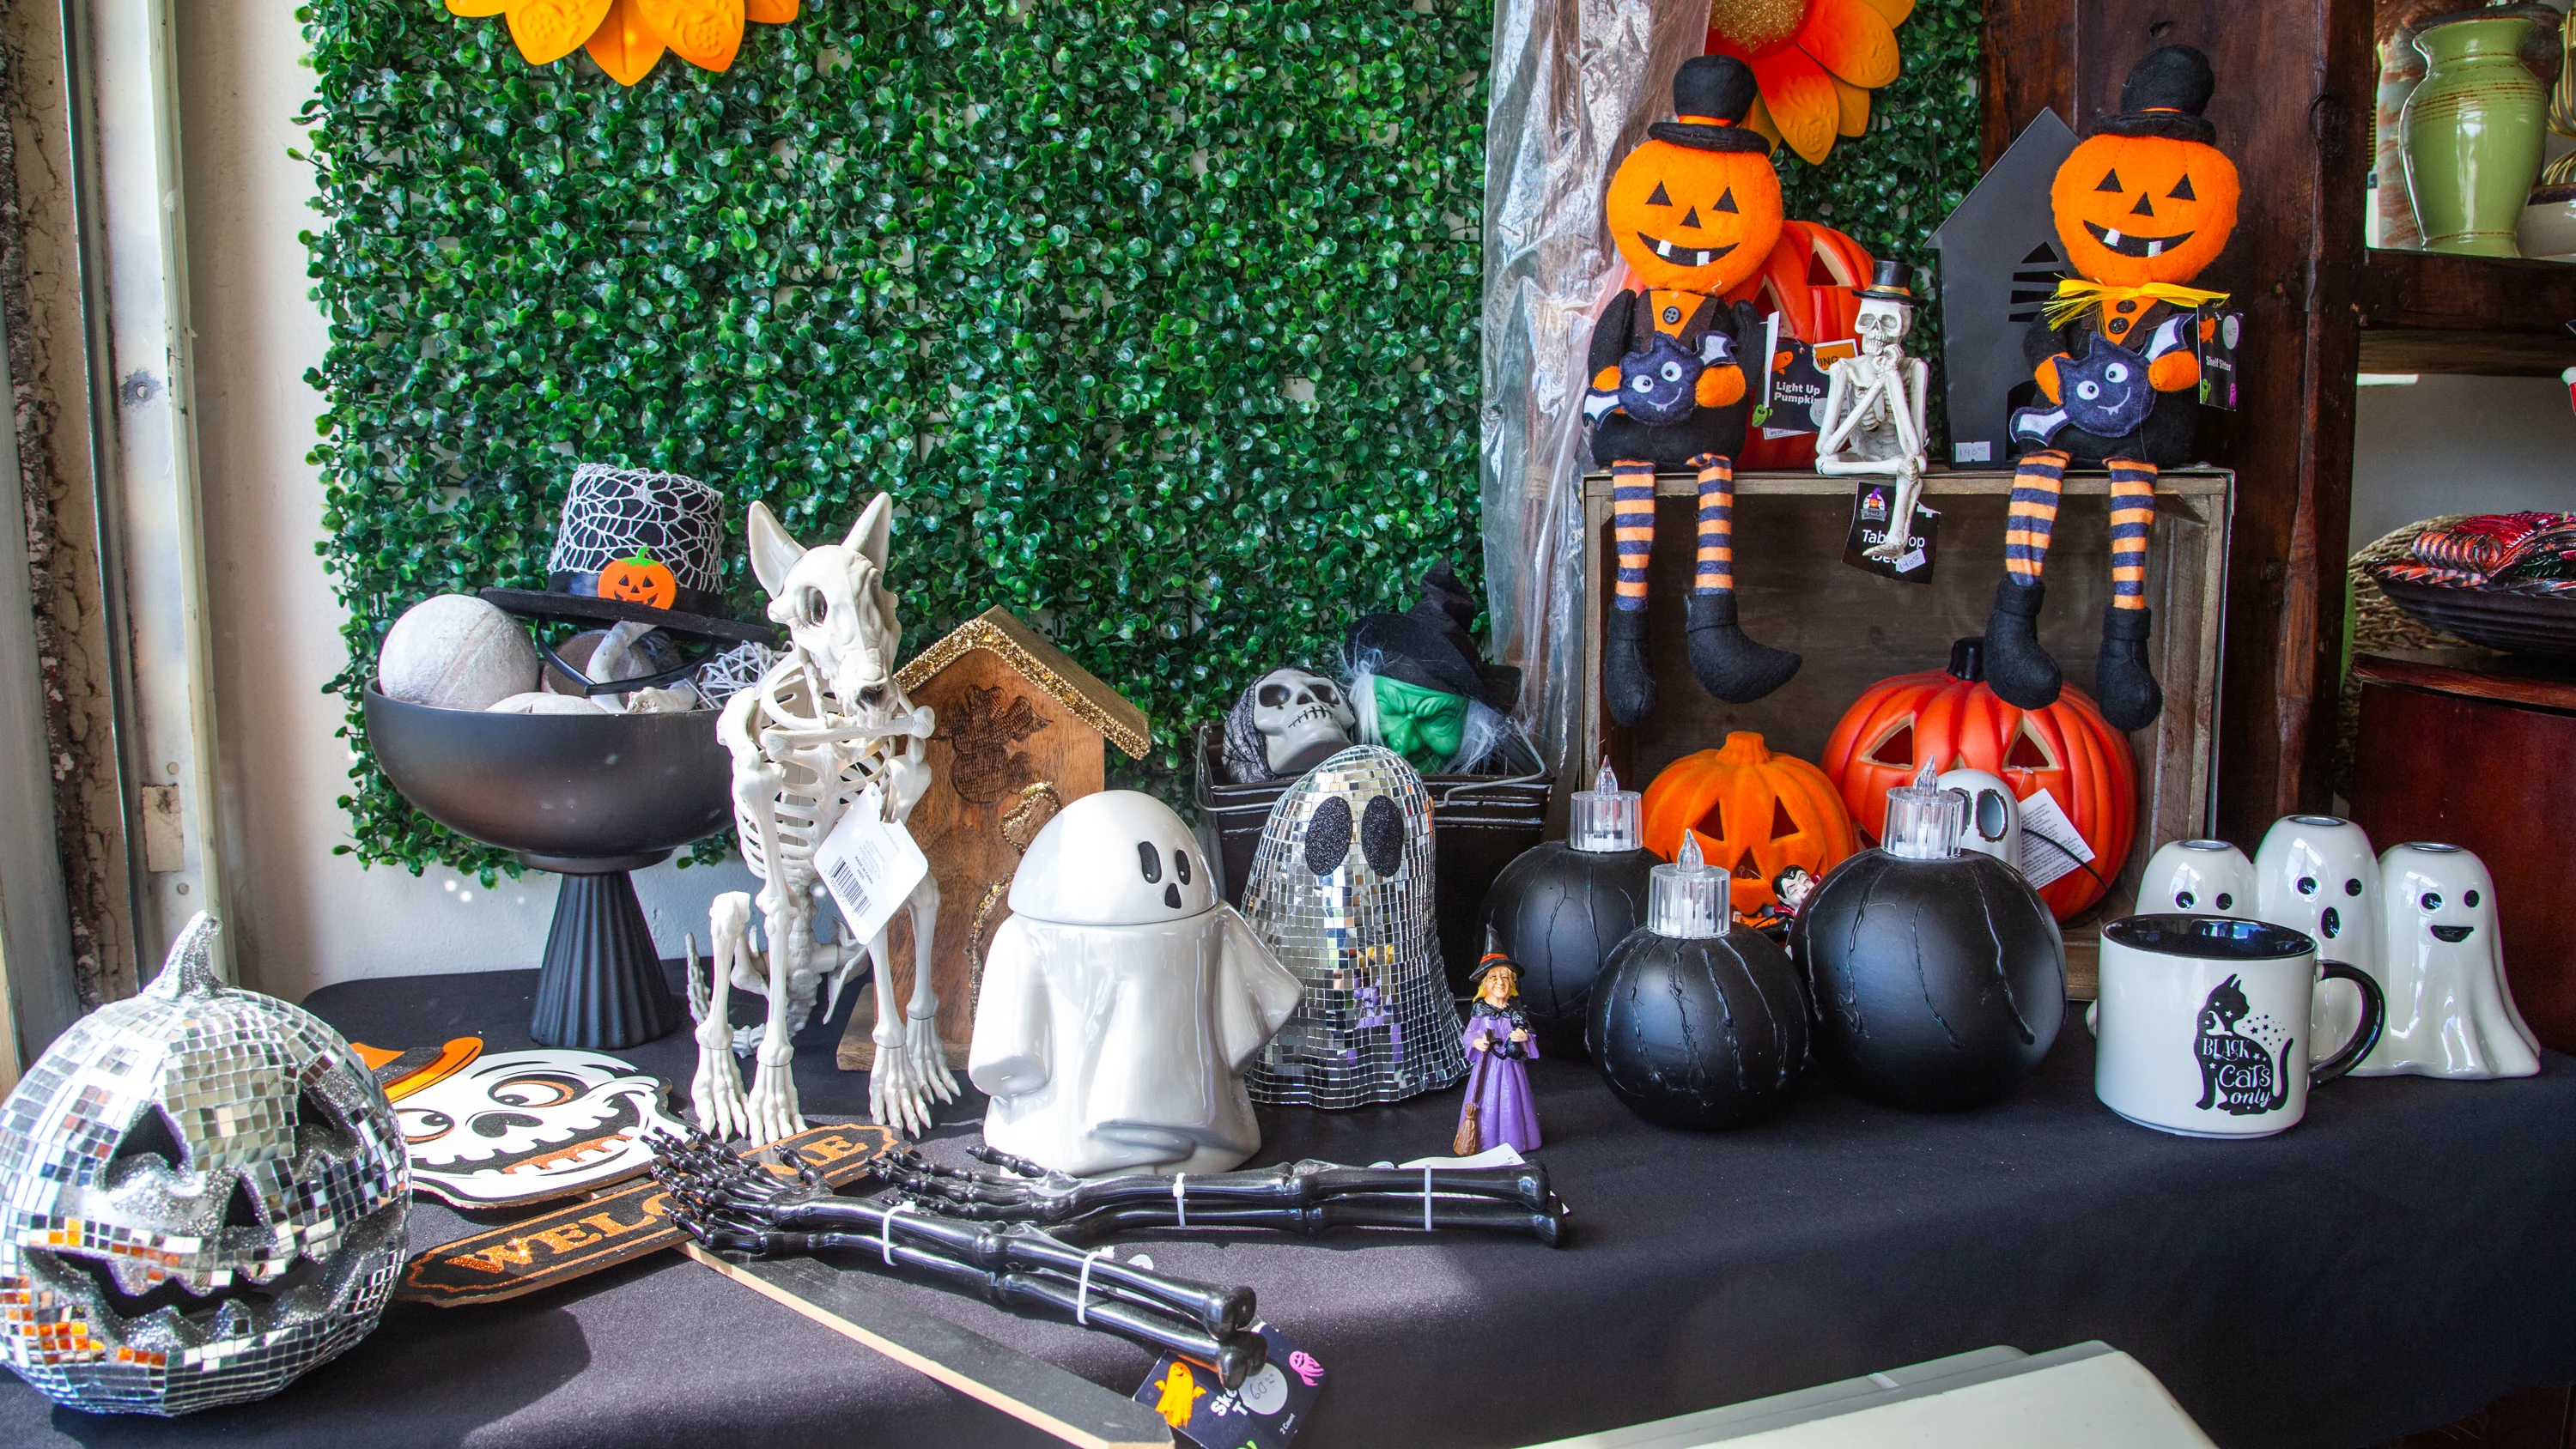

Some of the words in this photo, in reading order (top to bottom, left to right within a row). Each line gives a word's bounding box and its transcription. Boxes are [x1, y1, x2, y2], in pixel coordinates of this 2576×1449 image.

[2206, 355, 2219, 367] Shelf
[2219, 359, 2232, 371] Sitter
[1777, 381, 1803, 393] Light
[1806, 385, 1820, 396] Up
[1774, 392, 1814, 404] Pumpki
[1862, 529, 1886, 544] Tab
[1908, 533, 1925, 549] op
[2202, 1038, 2250, 1061] BLACK
[2230, 1088, 2271, 1107] only
[444, 1135, 869, 1274] WELCE
[1282, 1413, 1296, 1430] Count
